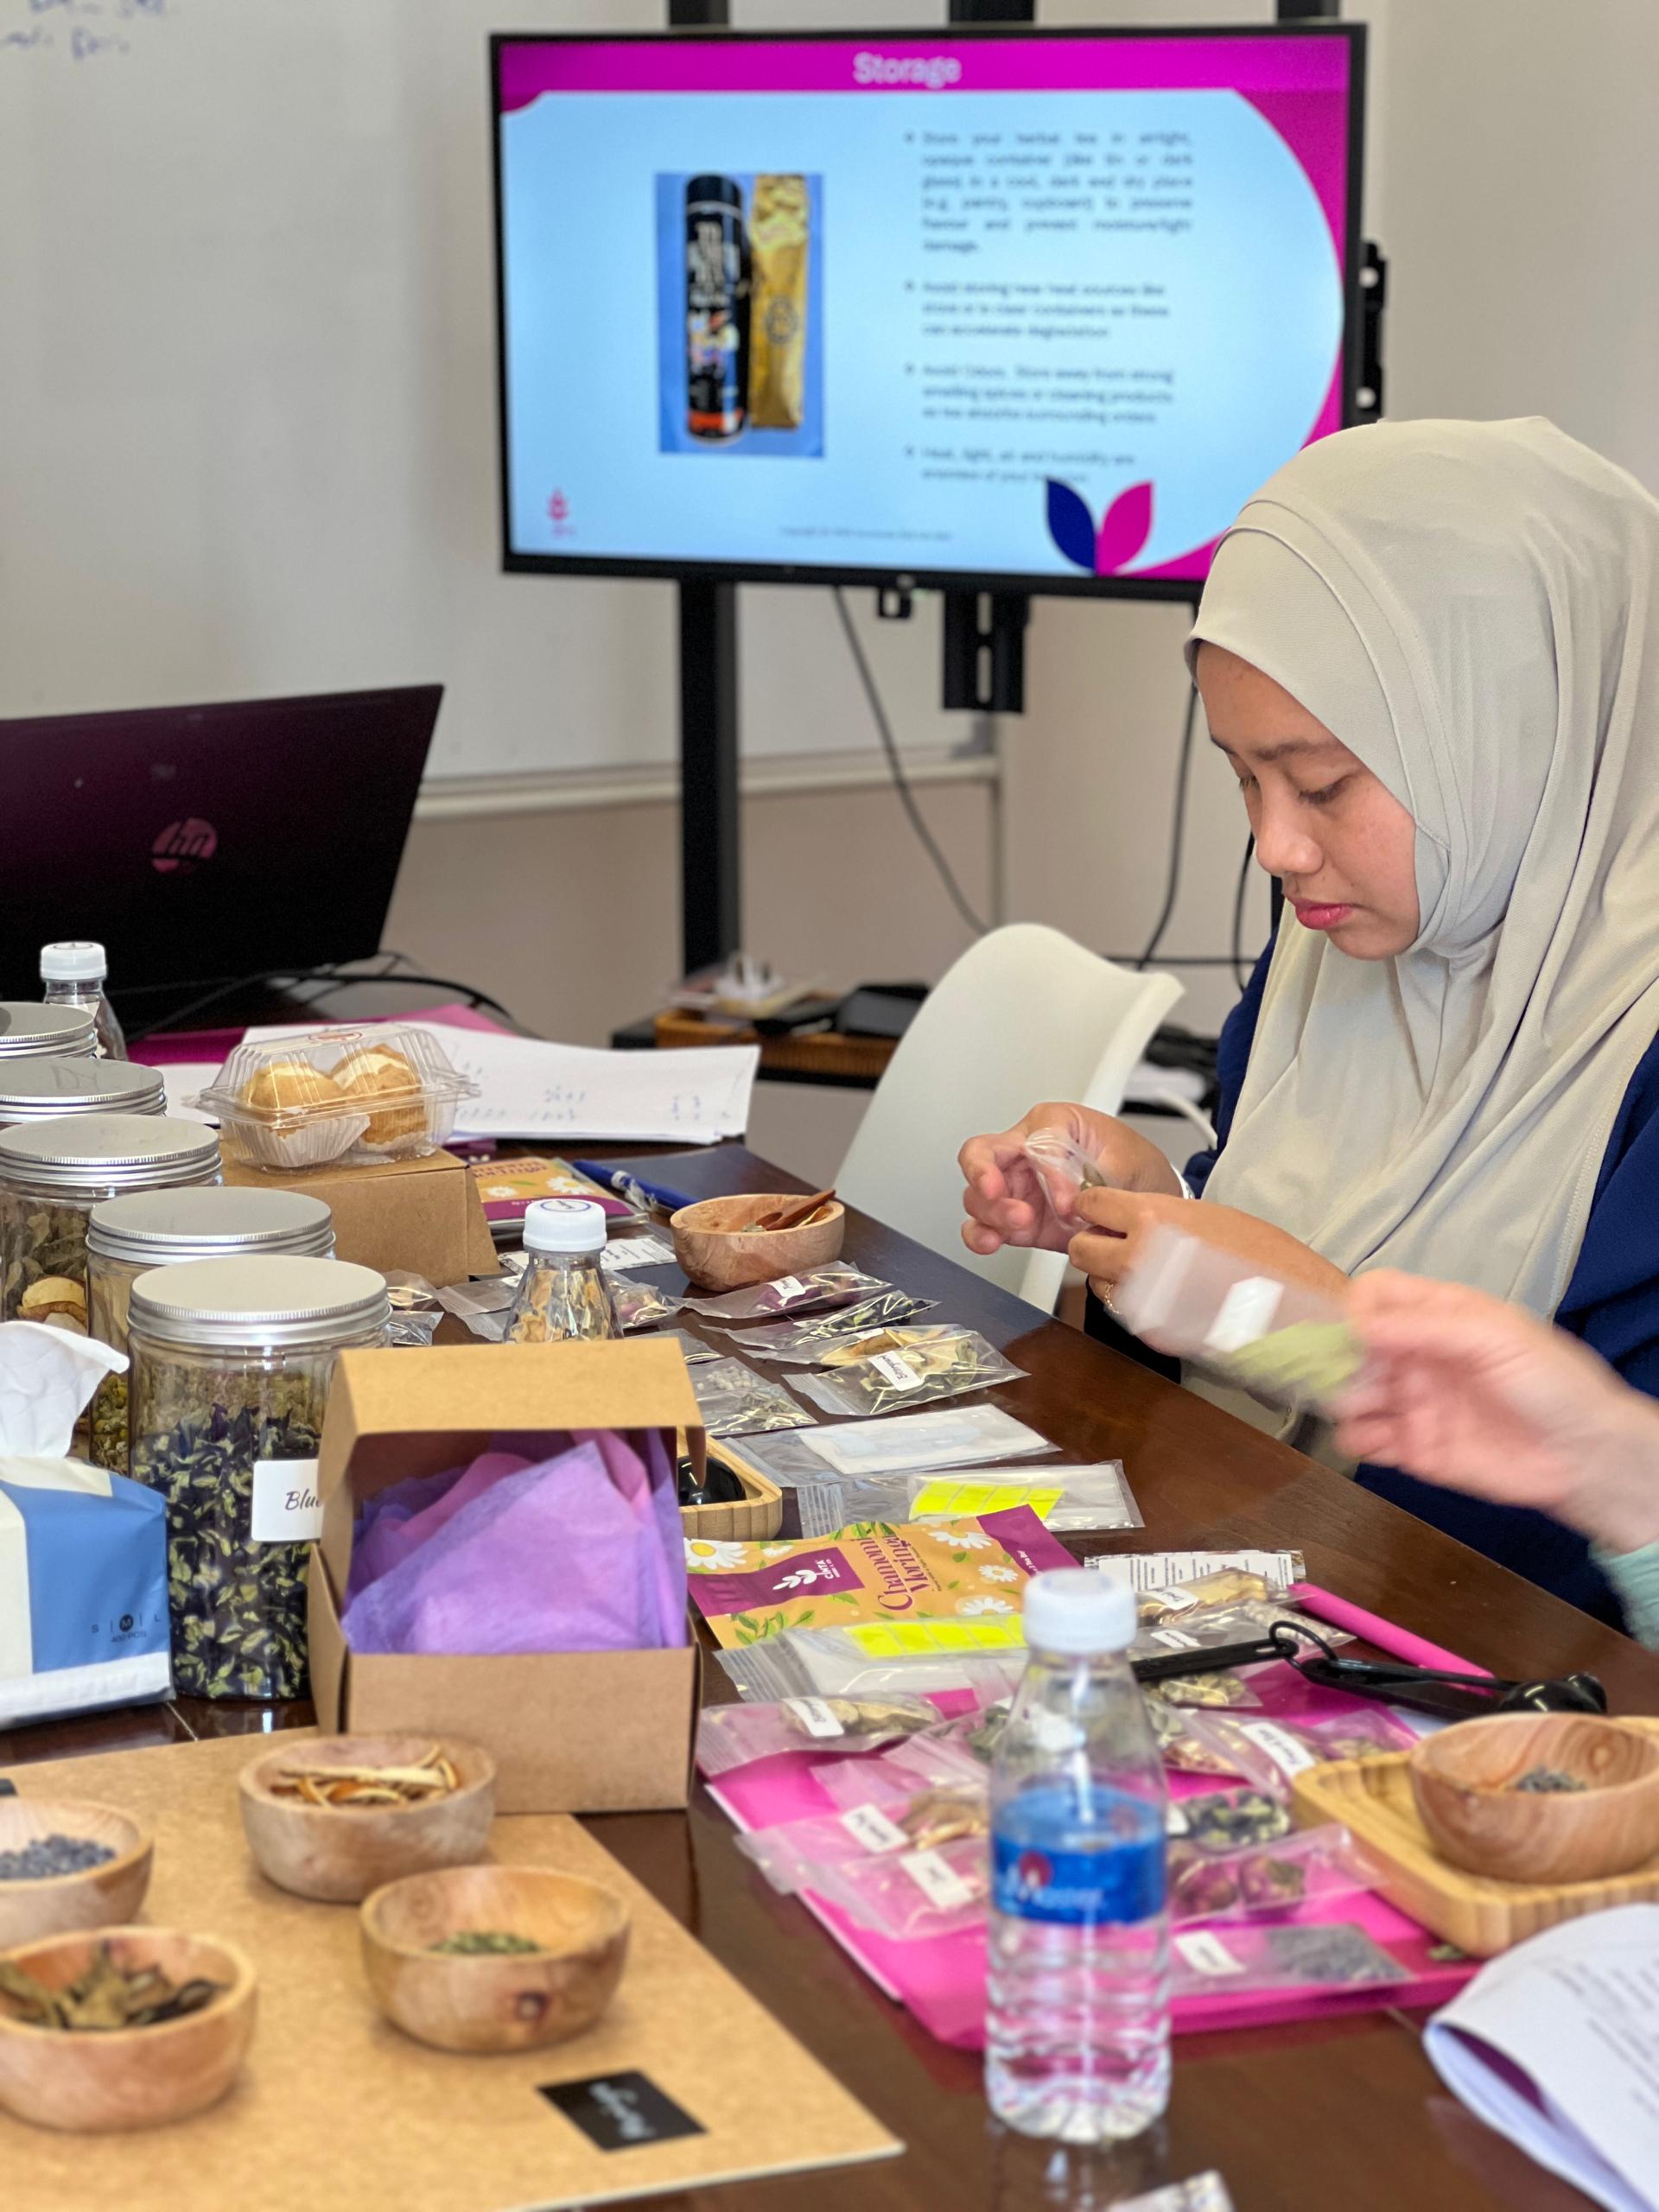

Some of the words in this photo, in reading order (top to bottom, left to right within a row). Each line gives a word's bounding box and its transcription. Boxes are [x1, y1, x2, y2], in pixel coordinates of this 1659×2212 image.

[853, 52, 962, 89] Storage
[157, 817, 215, 874] hp
[850, 1537, 913, 1611] Chamomi
[91, 1624, 99, 1633] S
[154, 1613, 162, 1622] L
